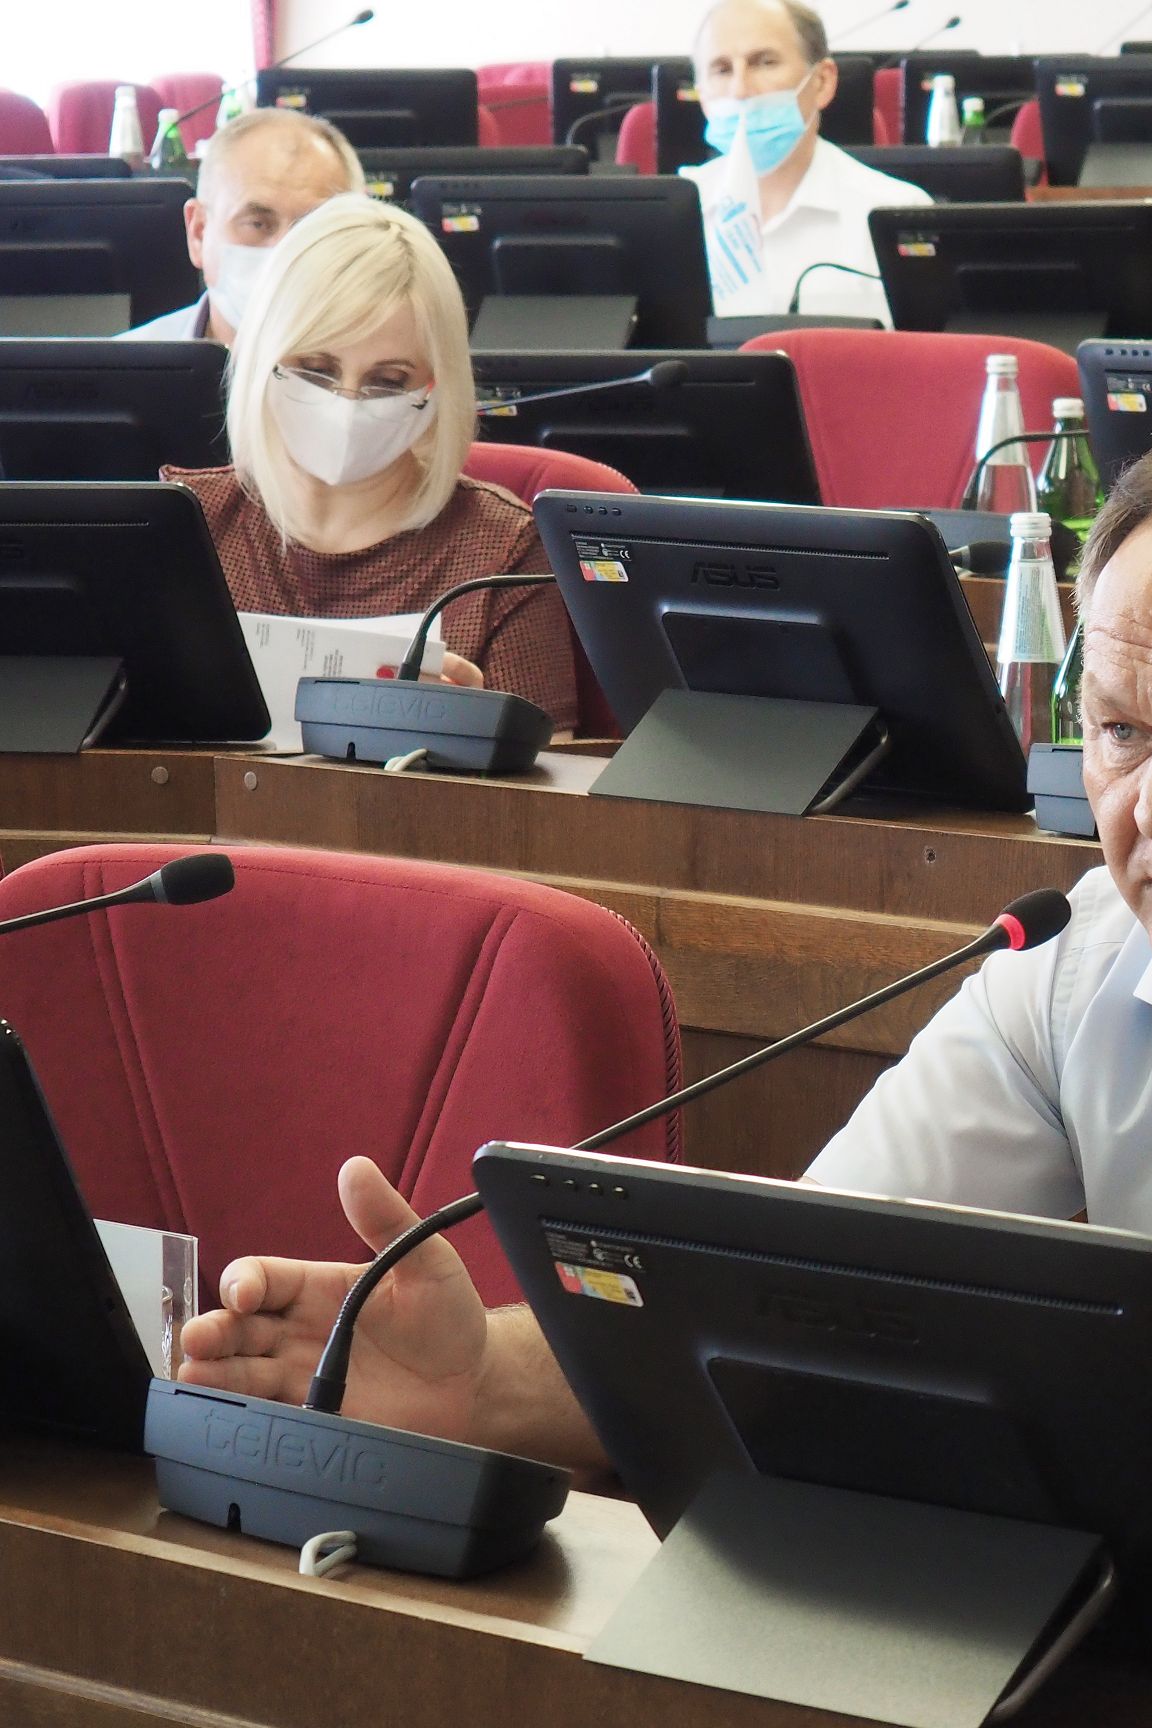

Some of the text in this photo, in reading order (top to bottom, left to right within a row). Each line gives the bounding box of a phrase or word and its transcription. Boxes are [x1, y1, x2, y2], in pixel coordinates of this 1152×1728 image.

[690, 562, 780, 591] ASUS
[332, 685, 447, 720] televic
[204, 1407, 388, 1484] televic
